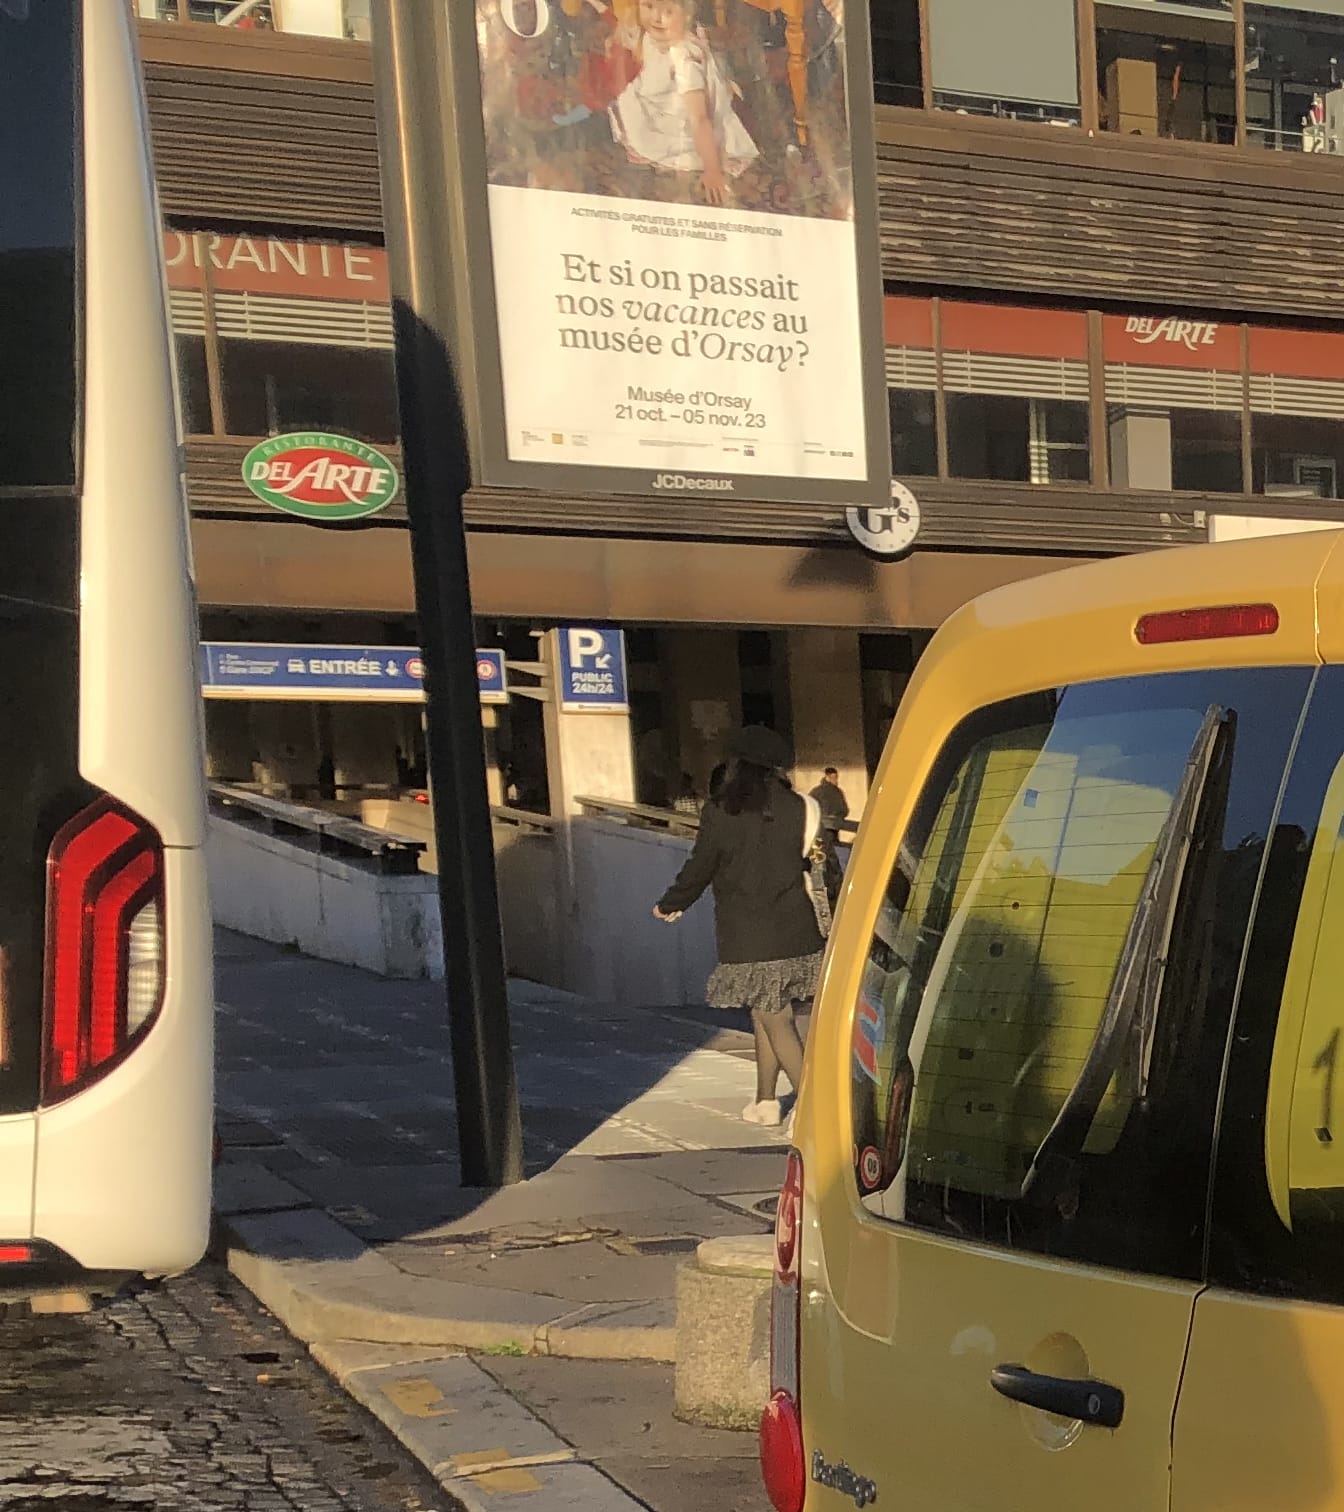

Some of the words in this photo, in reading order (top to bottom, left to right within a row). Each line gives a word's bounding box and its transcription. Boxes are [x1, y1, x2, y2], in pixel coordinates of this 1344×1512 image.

[622, 212, 676, 227] GRATUITES
[677, 218, 690, 228] ET
[691, 219, 717, 231] SANS
[631, 224, 659, 236] POUR
[660, 227, 679, 238] LES
[680, 229, 728, 242] FAMILLES
[560, 252, 601, 284] Et
[609, 259, 635, 287] si
[640, 267, 682, 292] on
[688, 273, 799, 301] passait
[555, 292, 615, 319] nos
[622, 299, 766, 331] vacances
[773, 313, 808, 335] au
[1125, 316, 1153, 334] DEL
[1133, 316, 1218, 351] ARTE
[558, 326, 663, 355] musée
[627, 385, 686, 406] Musée
[615, 404, 633, 419] 21
[637, 407, 668, 423] oct.
[683, 409, 704, 425] 05
[708, 412, 742, 427] nov.
[745, 413, 766, 429] 23
[263, 435, 377, 463] RISTORANTE
[251, 461, 293, 482] DEL
[263, 456, 391, 507] ARTE
[652, 473, 736, 491] JCDecaux
[568, 628, 604, 668] P
[309, 657, 381, 676] ENTRÉE
[571, 671, 614, 683] PUBLIC
[572, 682, 615, 695] 24h/24
